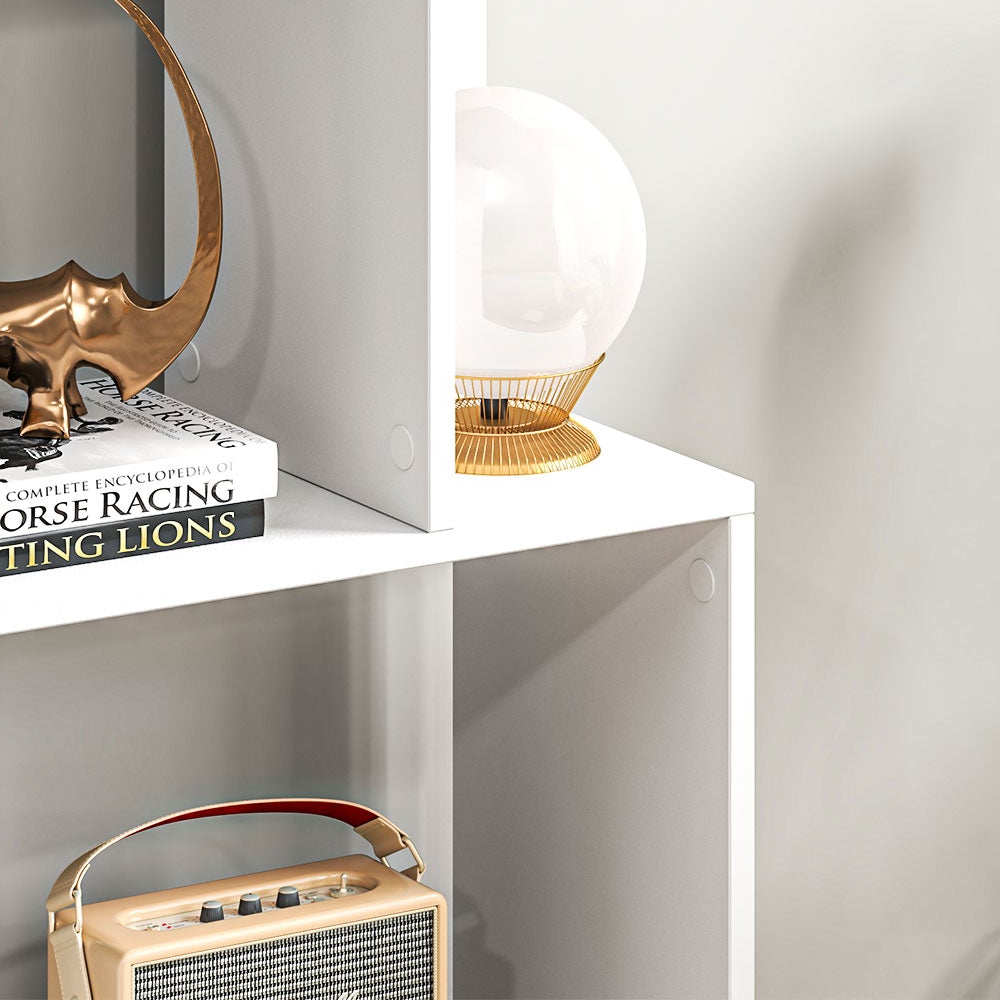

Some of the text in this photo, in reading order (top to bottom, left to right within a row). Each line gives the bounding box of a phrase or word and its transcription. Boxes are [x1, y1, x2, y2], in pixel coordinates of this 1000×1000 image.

[150, 410, 247, 449] RACING
[6, 480, 89, 502] COMPLETE
[95, 465, 212, 490] ENCYCLOPEDIA
[100, 479, 235, 519] RACING
[116, 511, 236, 554] LIONS
